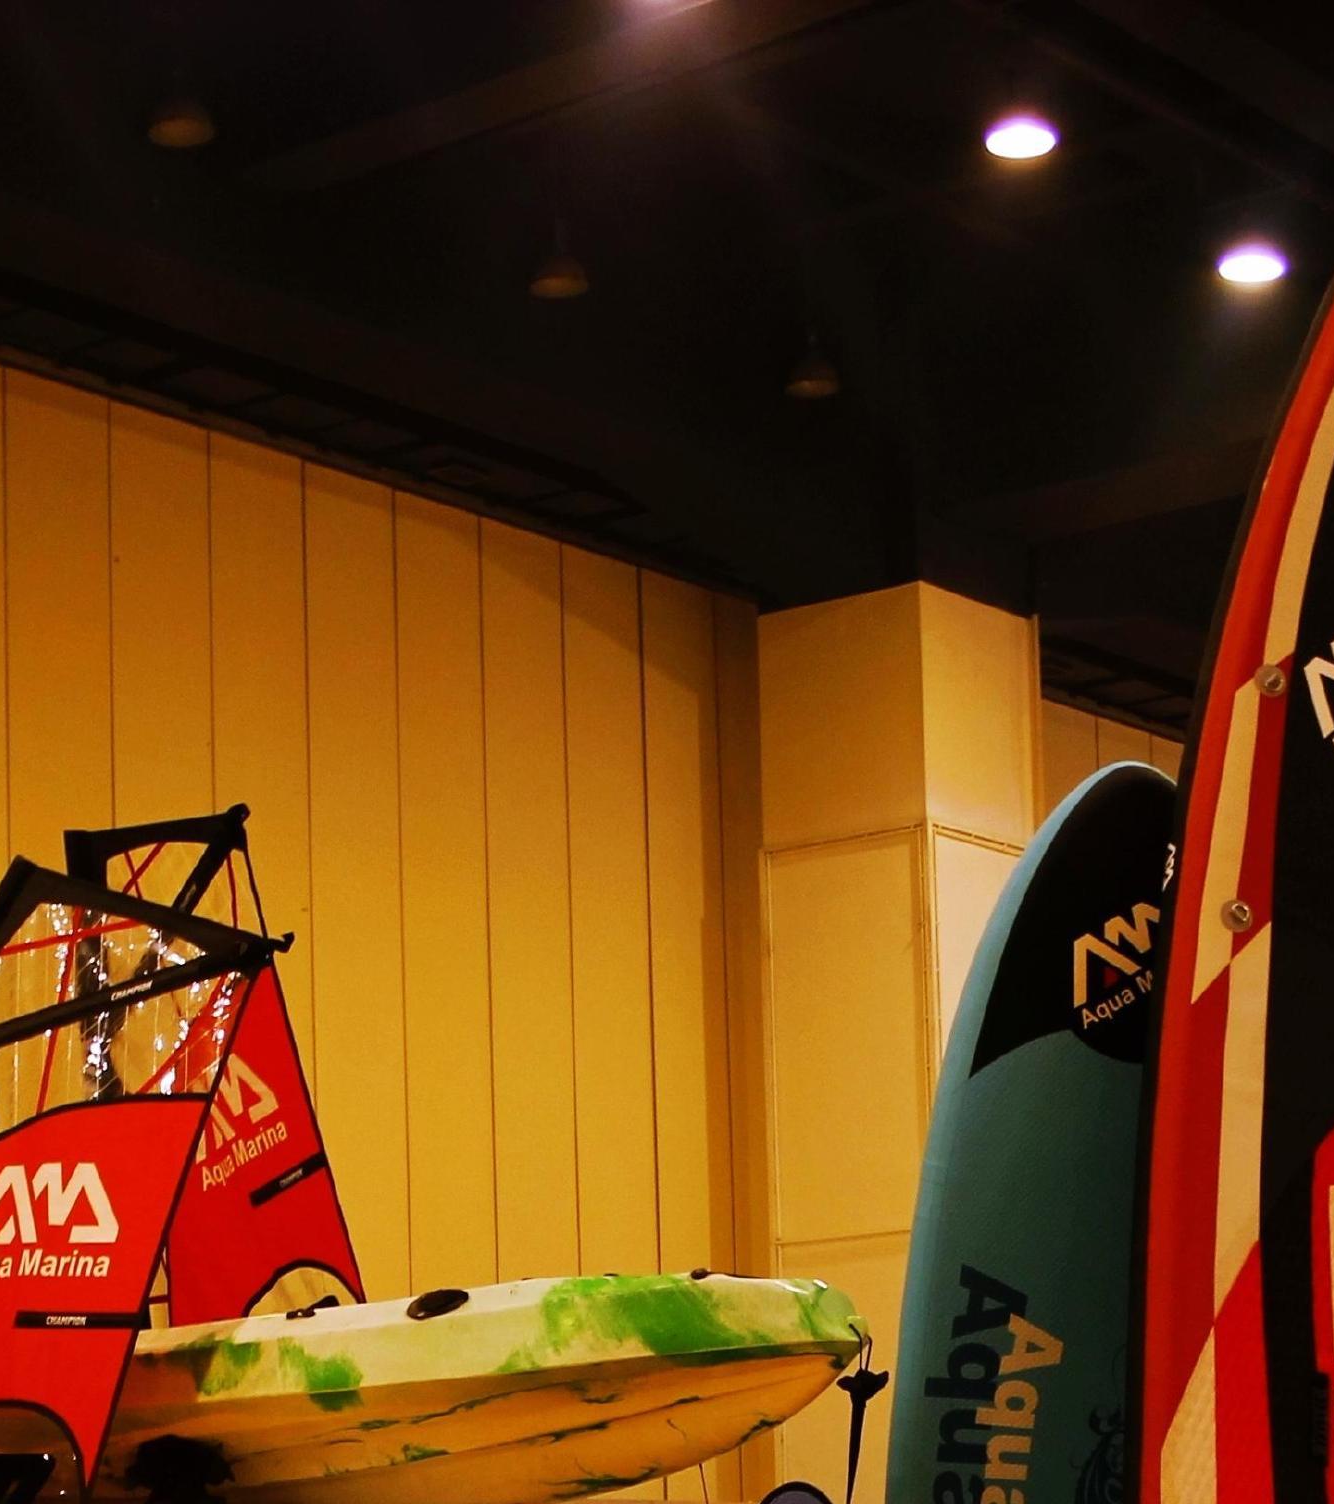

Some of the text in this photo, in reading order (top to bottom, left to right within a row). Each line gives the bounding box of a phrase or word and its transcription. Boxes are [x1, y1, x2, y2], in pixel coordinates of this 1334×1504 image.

[1081, 988, 1136, 1030] Aqua
[201, 1120, 288, 1192] Aqua Marina
[18, 1248, 110, 1278] Marina
[45, 1315, 87, 1327] CHAMPION
